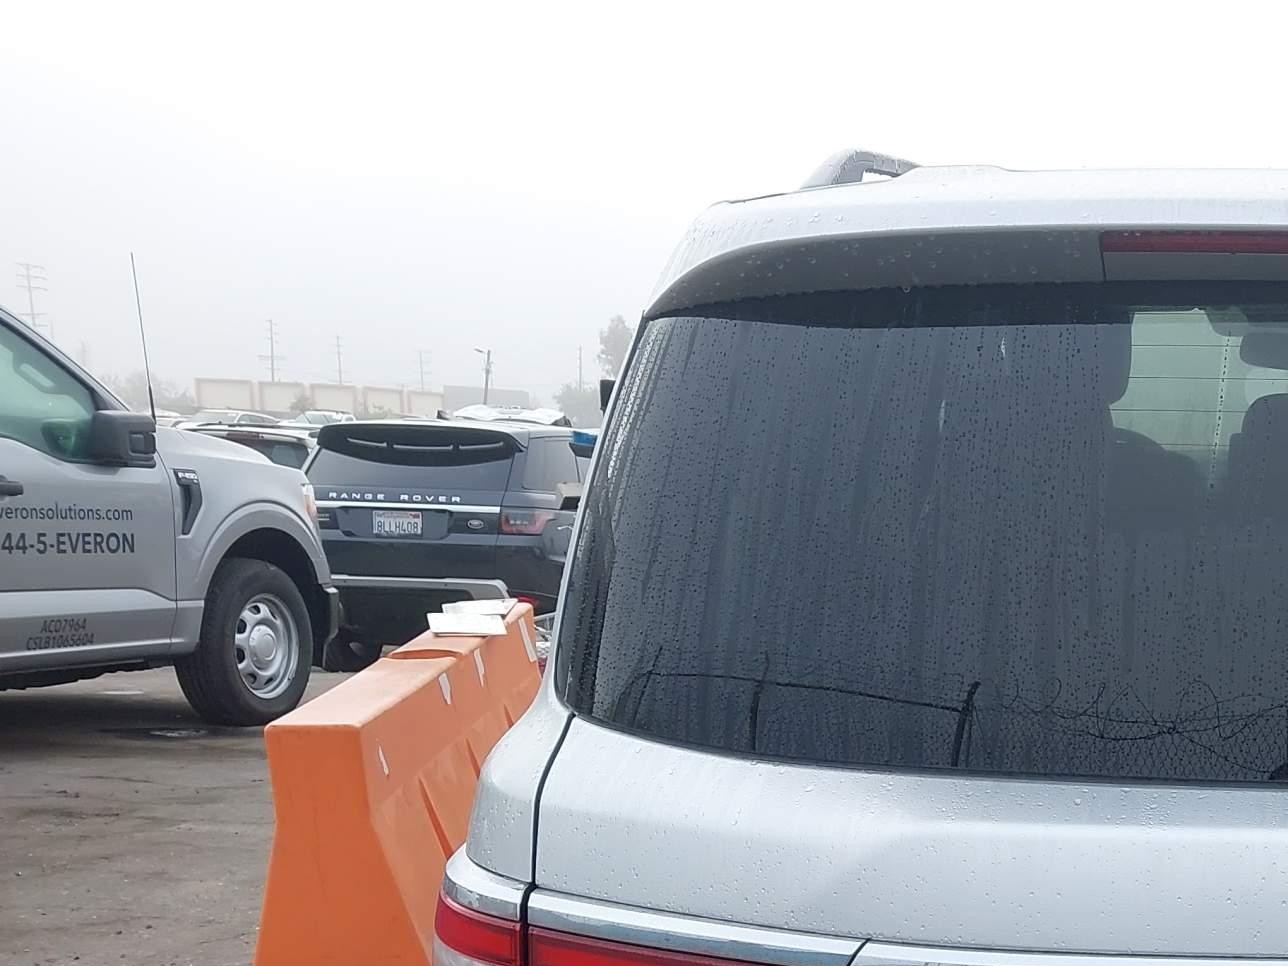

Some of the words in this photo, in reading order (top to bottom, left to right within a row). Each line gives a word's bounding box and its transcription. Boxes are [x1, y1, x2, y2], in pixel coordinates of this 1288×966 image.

[328, 491, 386, 501] RANGE
[399, 494, 461, 504] ROVER
[1, 532, 136, 555] 44-5-EVERON
